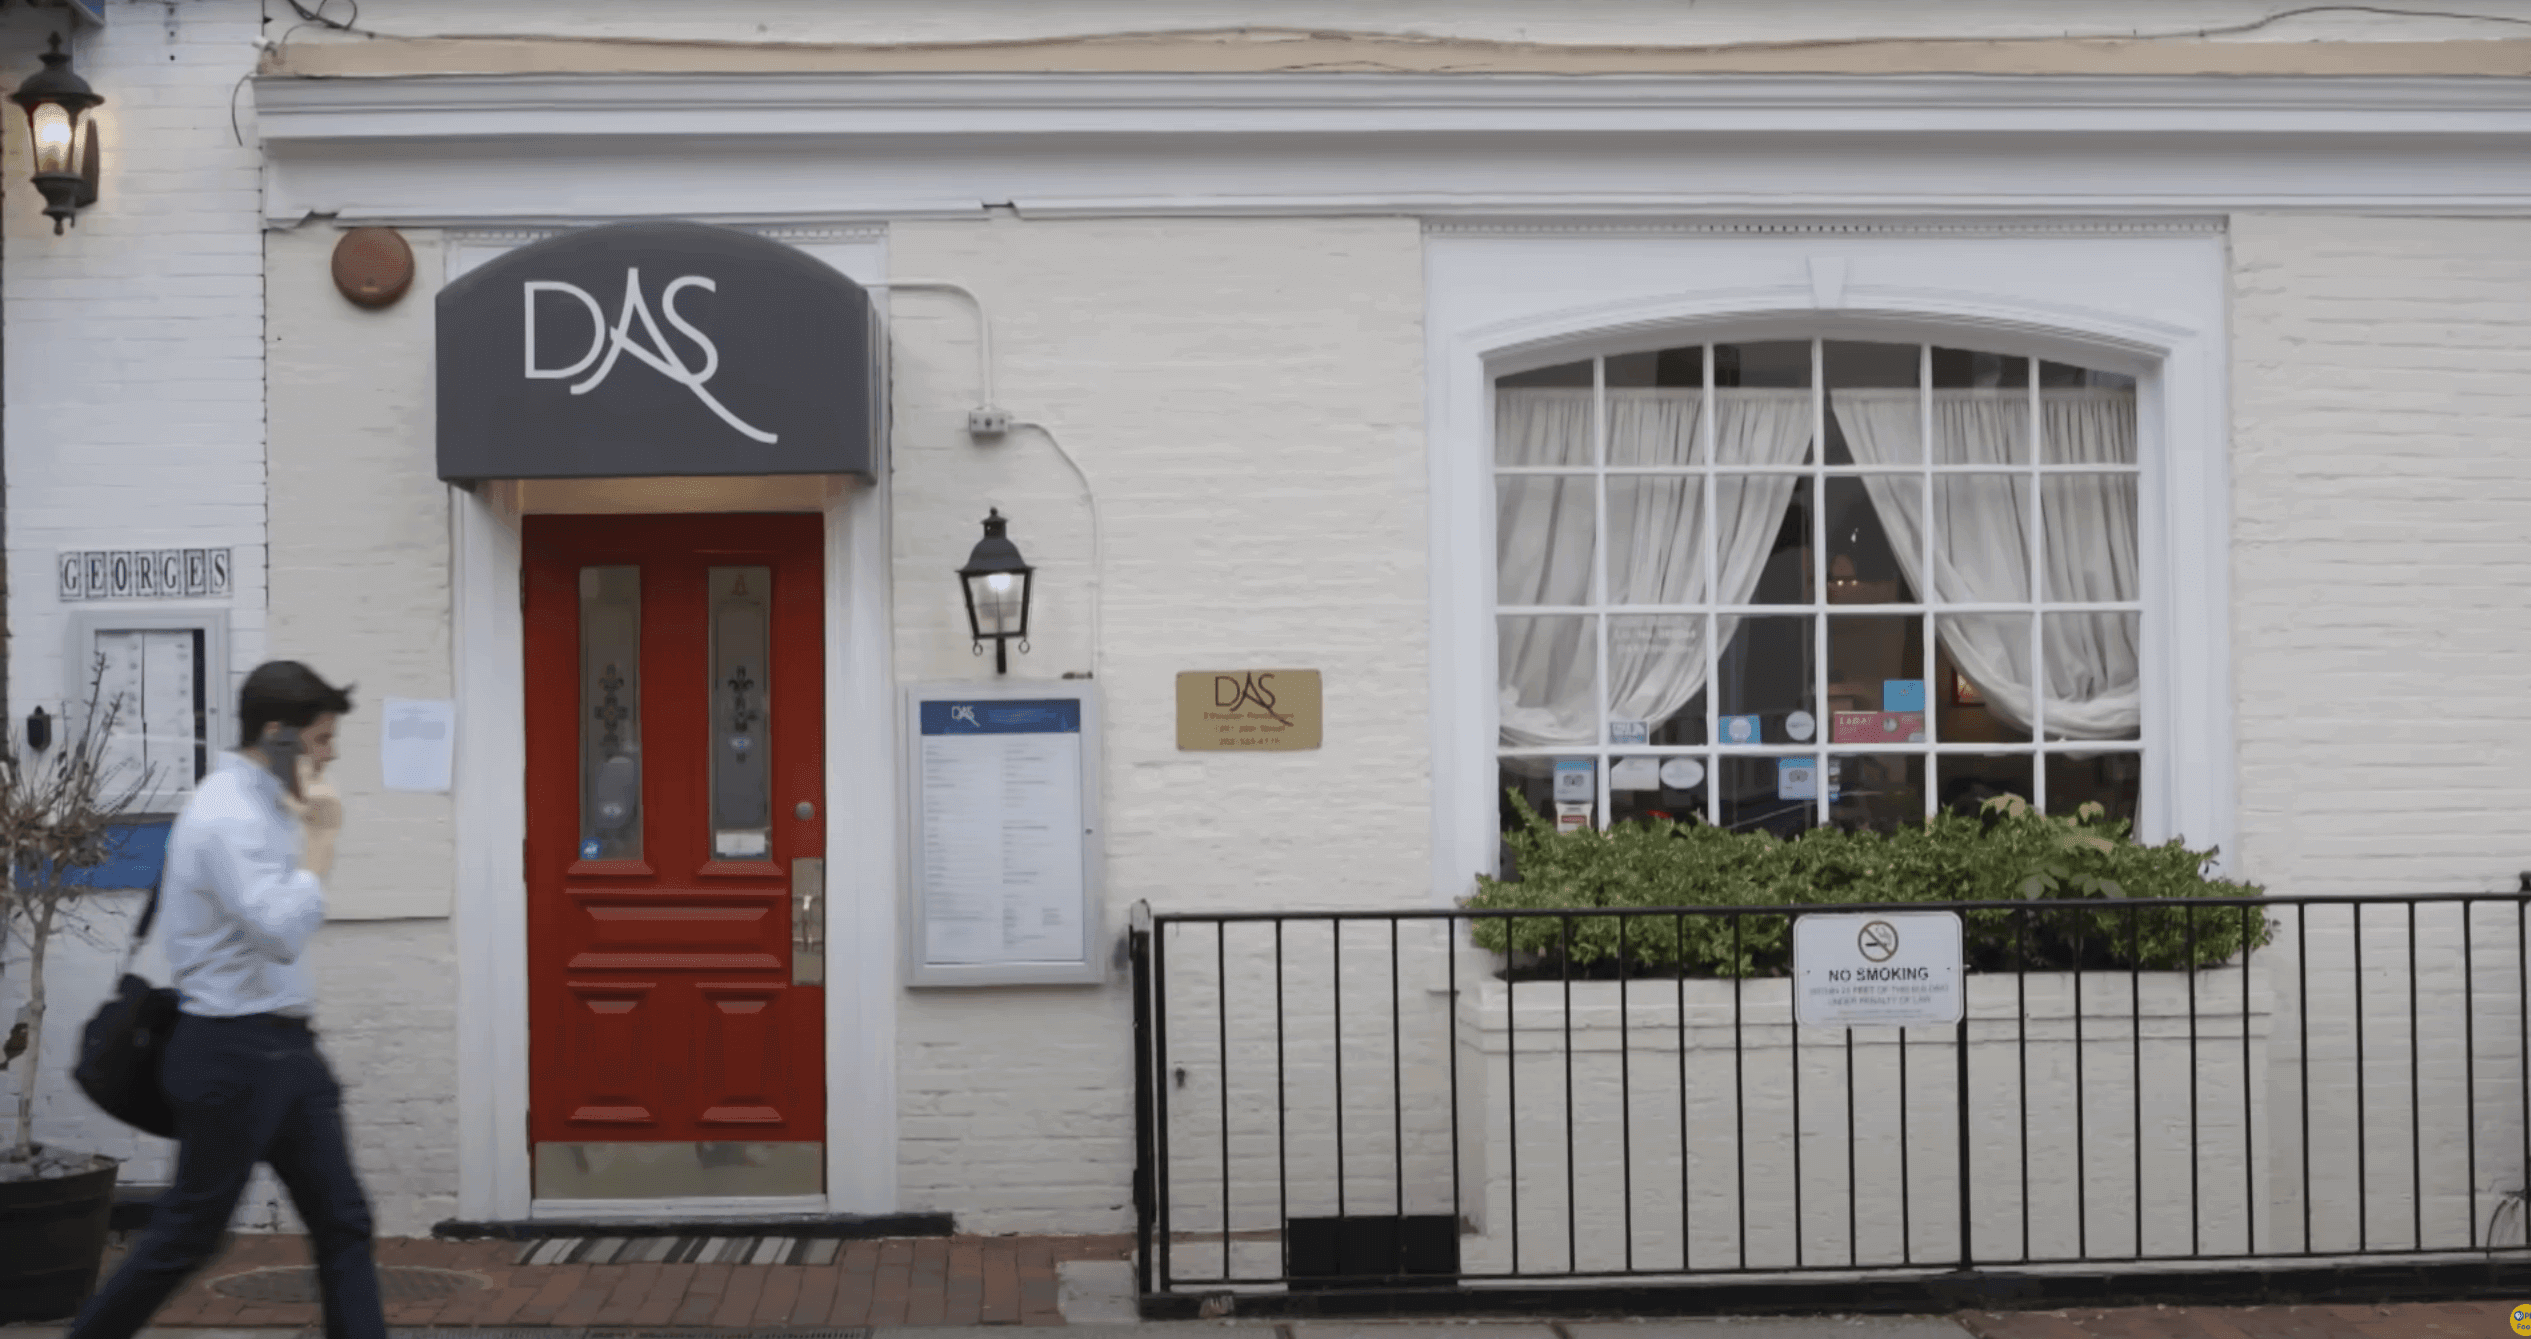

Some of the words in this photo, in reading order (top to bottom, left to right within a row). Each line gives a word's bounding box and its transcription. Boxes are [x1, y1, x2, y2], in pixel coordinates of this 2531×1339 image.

[524, 267, 778, 444] DAS
[64, 554, 225, 591] GEORGES
[1214, 671, 1294, 726] DAS
[1829, 969, 1851, 982] NO
[1857, 967, 1929, 981] SMOKING
